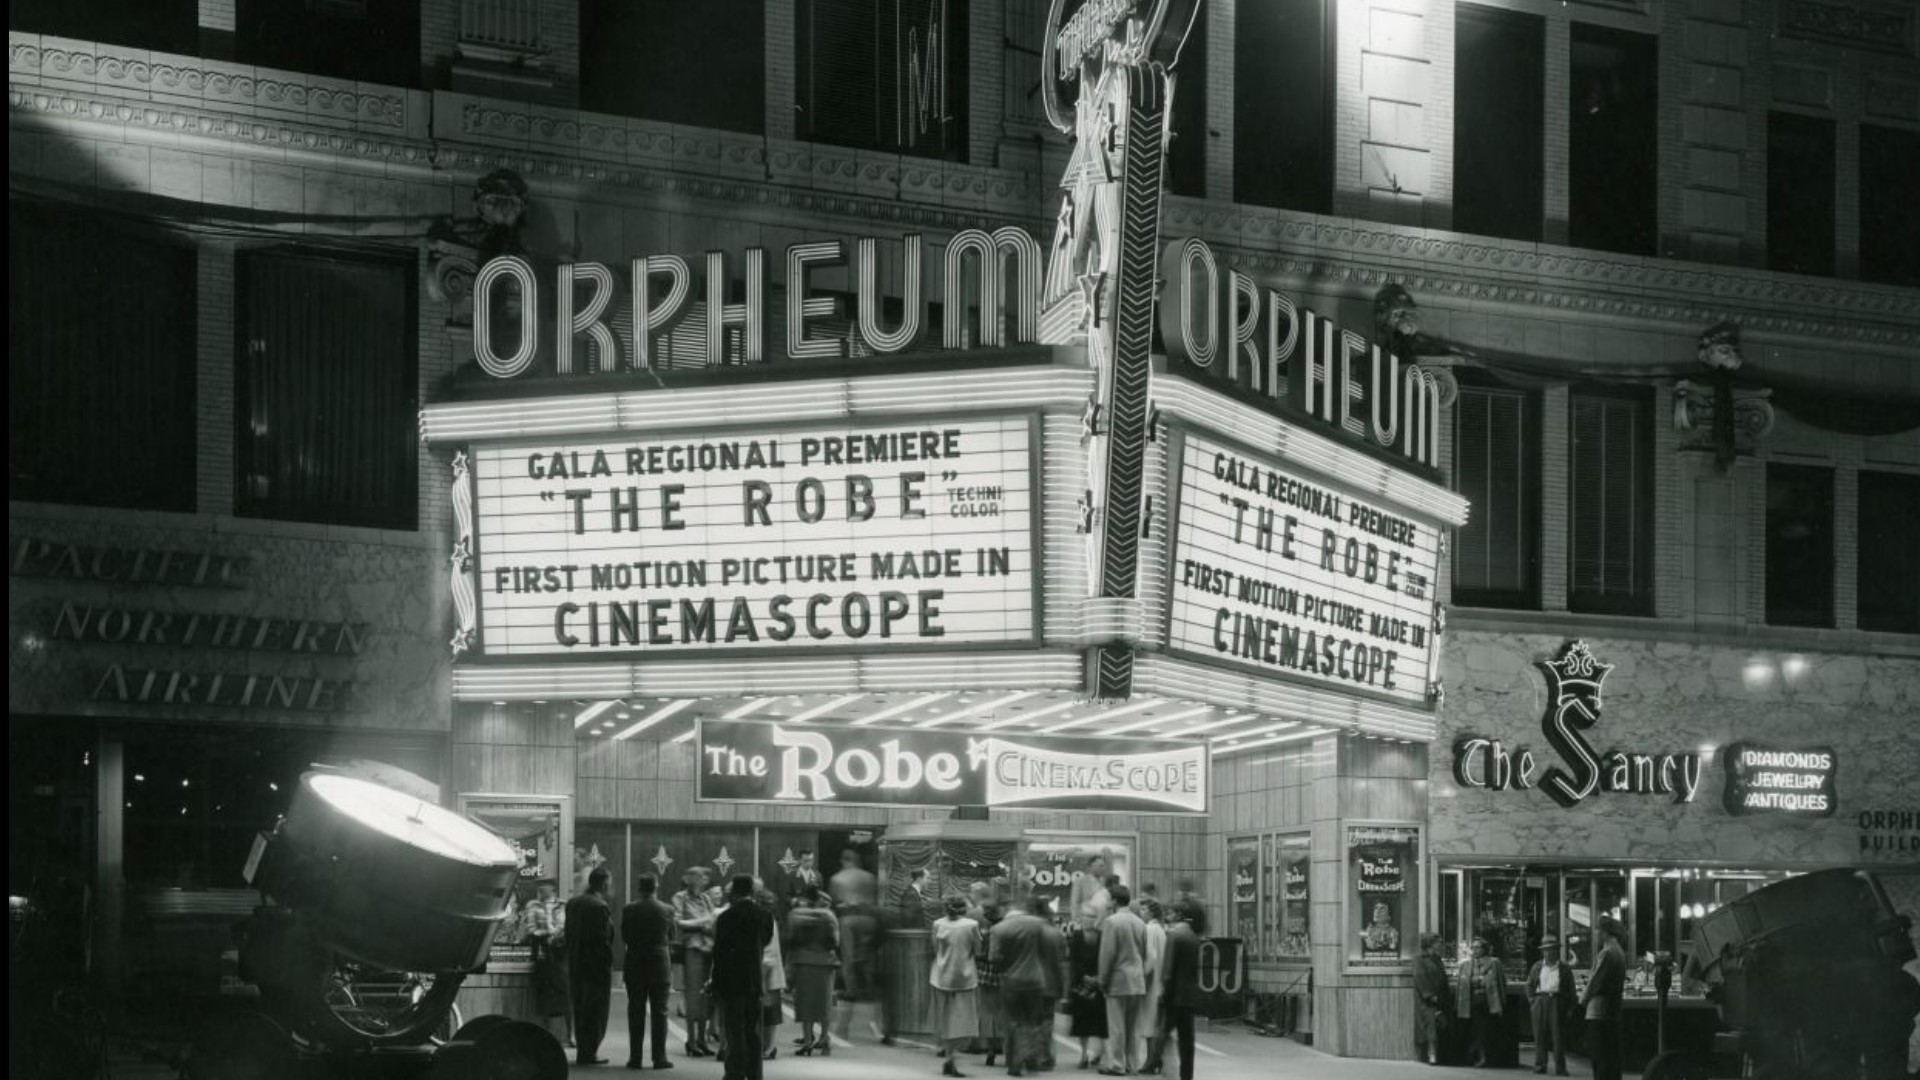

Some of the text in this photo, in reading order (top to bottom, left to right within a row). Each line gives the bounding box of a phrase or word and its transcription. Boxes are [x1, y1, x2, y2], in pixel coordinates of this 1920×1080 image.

[474, 225, 1041, 377] ORPHEUM
[1179, 237, 1440, 469] ORPHEUM
[527, 429, 962, 481] GALA REGIONAL PREMIERE
[946, 484, 1003, 504] TECHNI
[950, 503, 1001, 519] COLOR
[1214, 452, 1417, 548] GALA REGIONAL PREMIERE
[12, 537, 246, 590] PACIFIC
[495, 547, 1011, 595] FIRST MOTION PICTURE MADE IN
[52, 601, 364, 654] NORTHERN
[553, 589, 945, 649] CINEMASCOPE
[1184, 558, 1426, 650] FIRST MOTION PICTURE MADE IN
[1212, 606, 1399, 691] CINEMASCOPE
[704, 744, 769, 778] The
[772, 722, 963, 802] Robe
[1455, 697, 1702, 807] The Sancy
[1742, 748, 1832, 771] DIAMONDS
[1744, 791, 1829, 811] ANTIQUES
[1748, 770, 1827, 790] JEWELRY
[1362, 862, 1401, 877] Robe
